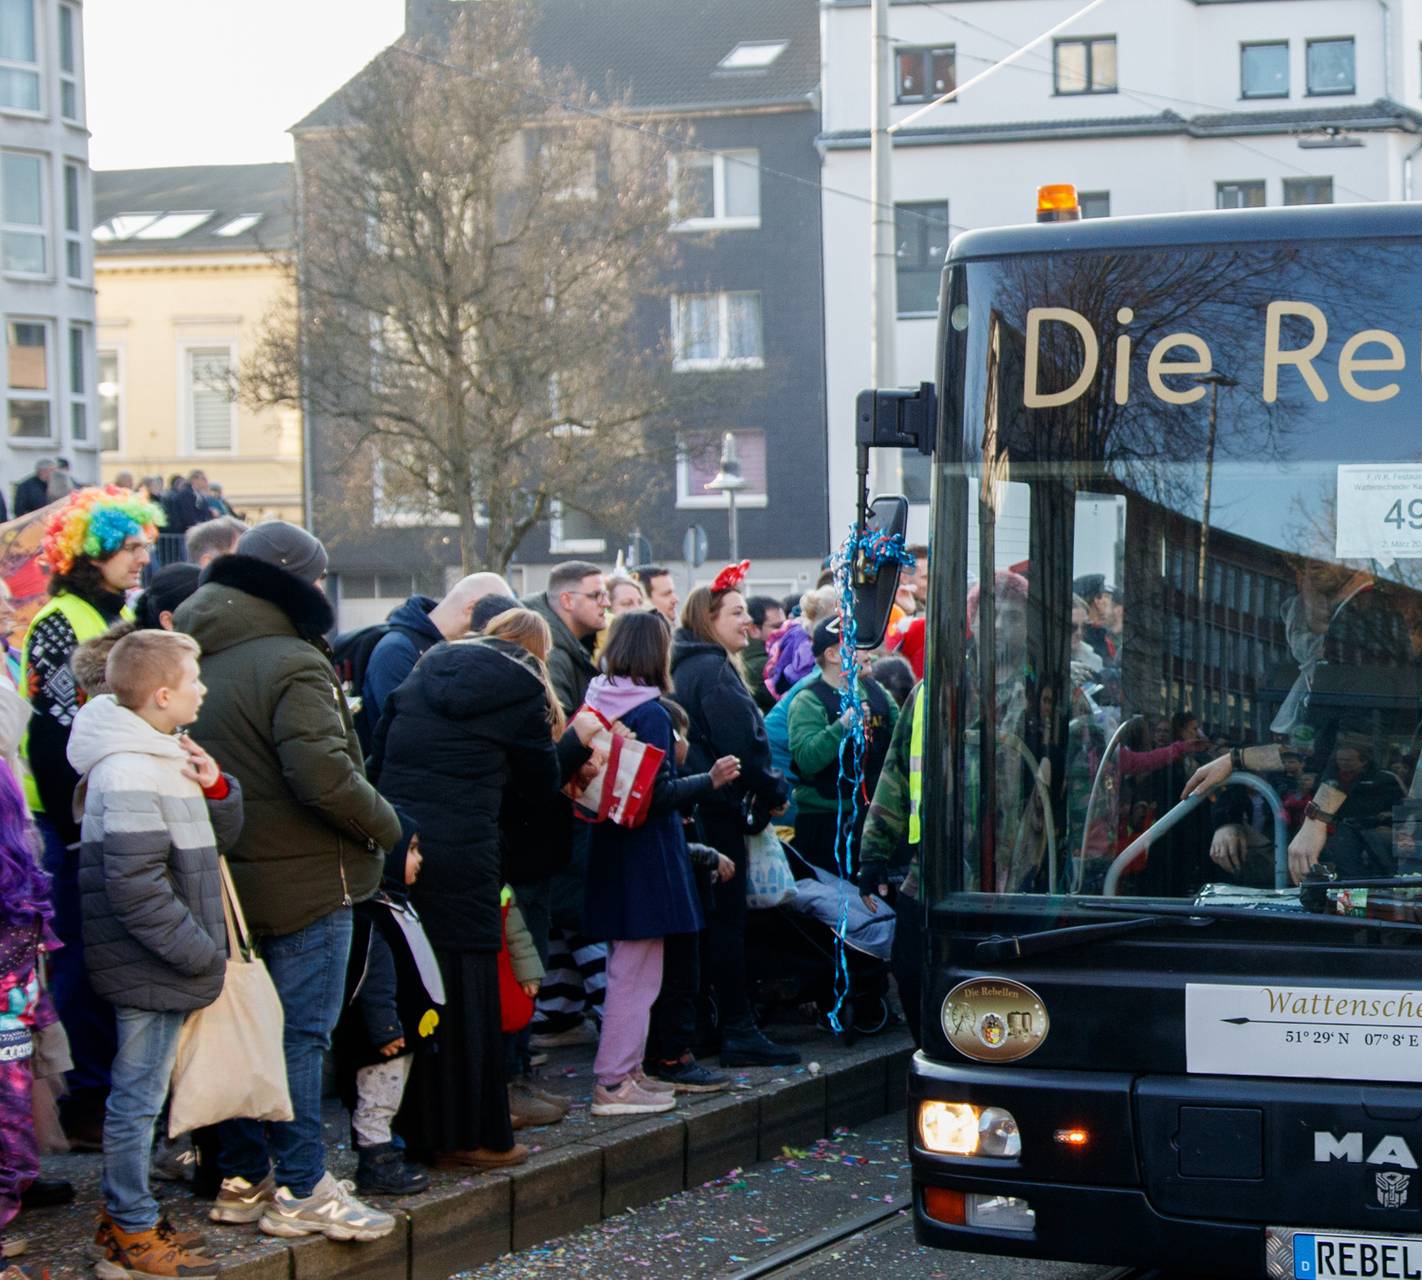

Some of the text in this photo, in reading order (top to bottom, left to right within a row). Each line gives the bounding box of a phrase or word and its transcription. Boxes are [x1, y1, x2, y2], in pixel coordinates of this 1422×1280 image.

[1024, 307, 1212, 408] Die
[964, 986, 1020, 998] Die Rebellen
[1286, 1031, 1309, 1044] 51°
[1338, 1032, 1350, 1045] N
[1364, 1033, 1388, 1047] 07°
[1409, 1034, 1419, 1048] E
[1301, 1260, 1310, 1272] D
